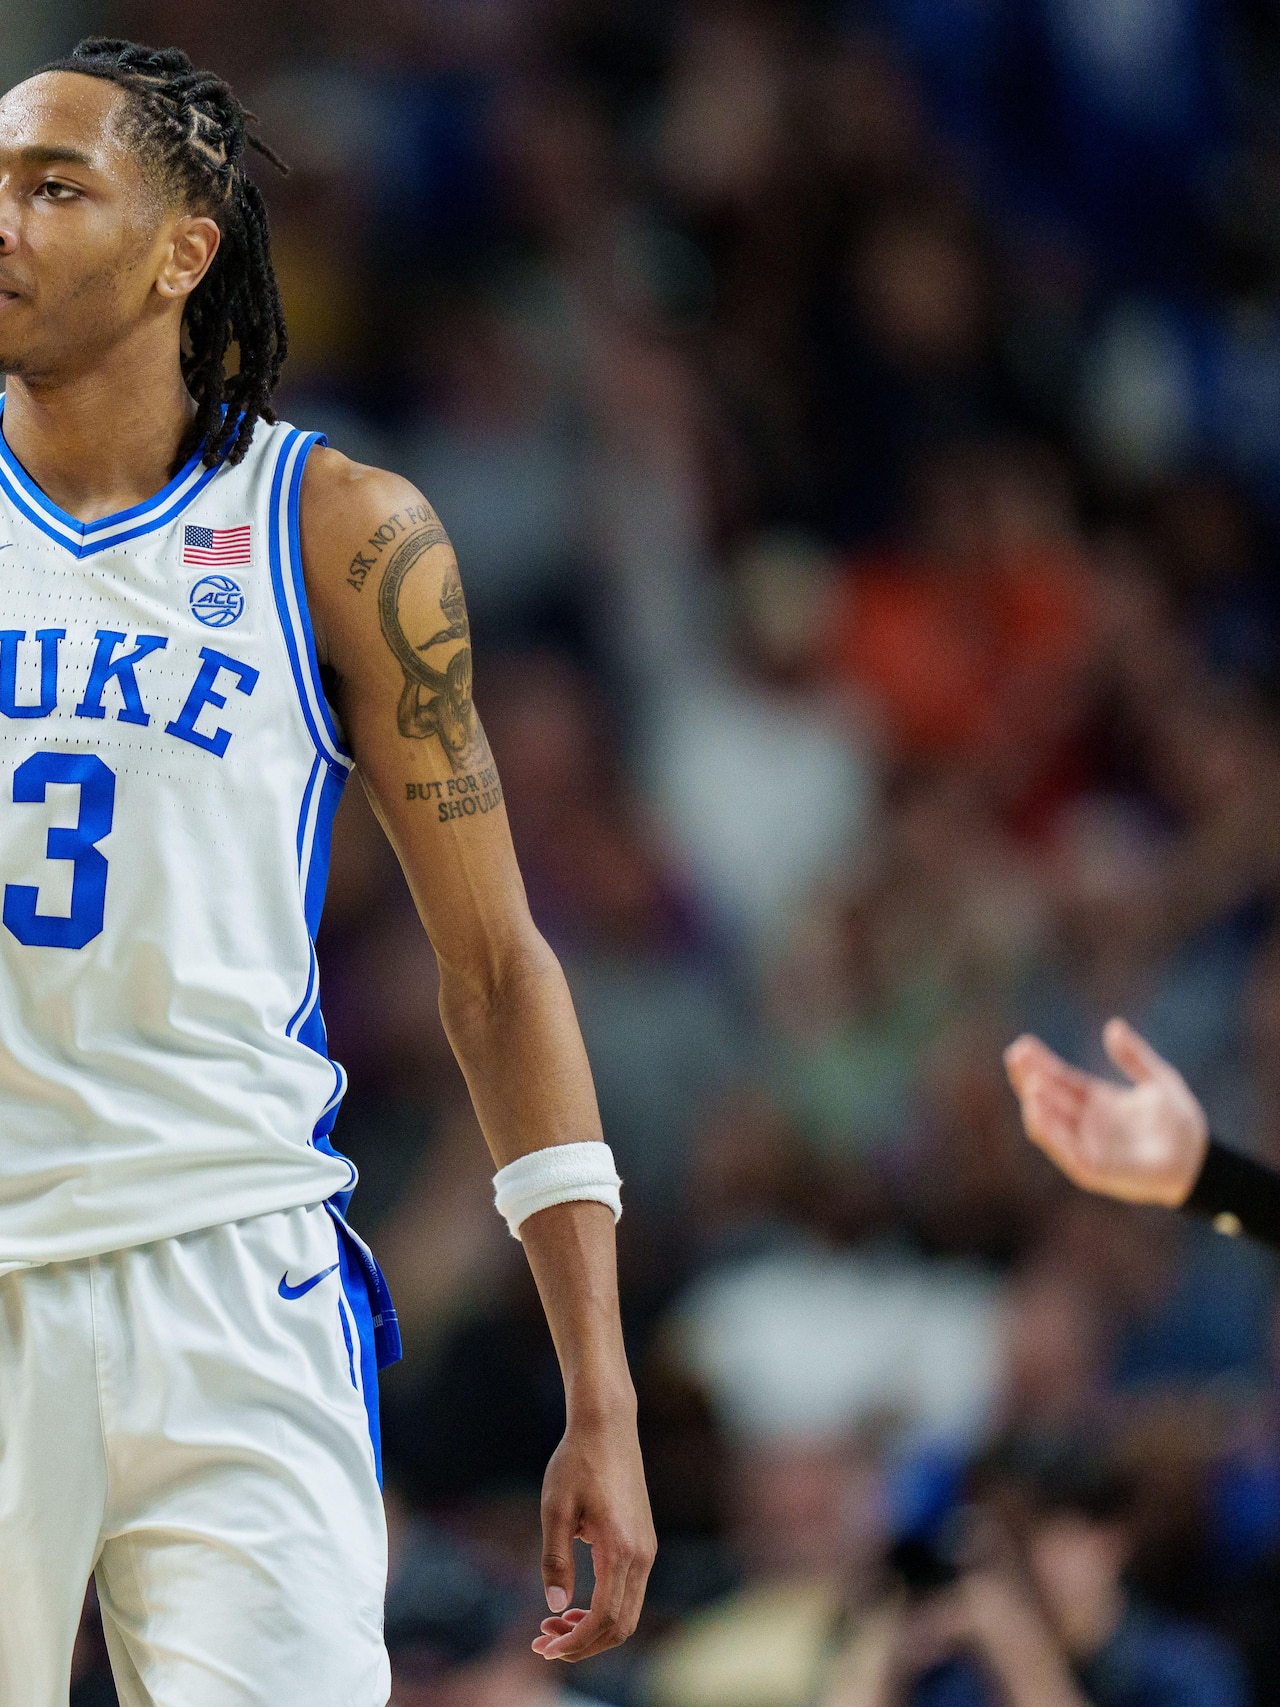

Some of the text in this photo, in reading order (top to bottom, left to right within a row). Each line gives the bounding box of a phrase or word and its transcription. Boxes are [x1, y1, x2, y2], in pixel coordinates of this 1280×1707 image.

[346, 551, 378, 593] ASK
[368, 513, 407, 552] NOT
[197, 592, 242, 604] ACC
[405, 782, 442, 800] BUT
[447, 775, 479, 797] FOR
[2, 752, 116, 950] 3
